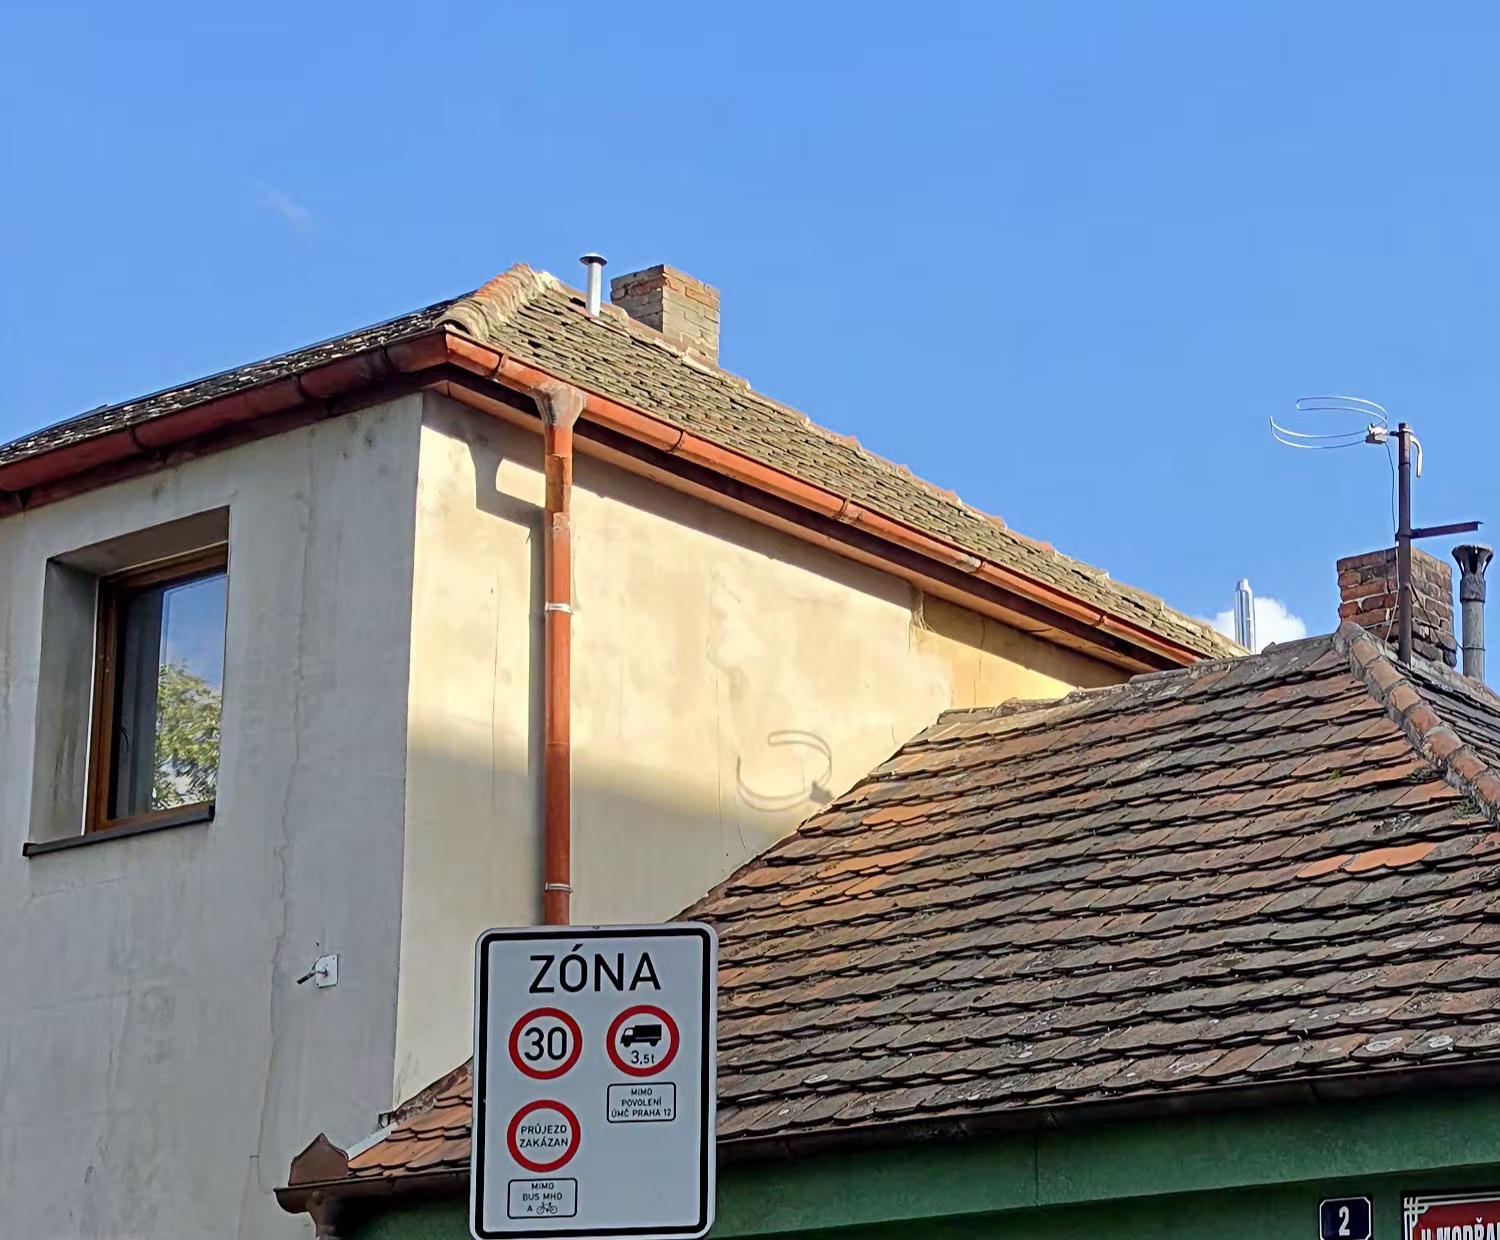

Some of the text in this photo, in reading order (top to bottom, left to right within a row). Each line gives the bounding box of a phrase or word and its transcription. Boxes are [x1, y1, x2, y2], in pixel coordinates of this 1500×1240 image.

[529, 944, 661, 993] ZÓNA
[523, 1027, 567, 1061] 30
[631, 1088, 653, 1096] MIMO
[621, 1097, 662, 1107] POVOLENÍ
[611, 1109, 672, 1118] ÚMČ PRAHA 12
[520, 1123, 567, 1135] PRŮJEZD
[519, 1136, 569, 1149] ZAKÁZAN
[531, 1182, 554, 1190] MIMO
[522, 1192, 563, 1201] BUS MHD
[1339, 1206, 1350, 1236] 2
